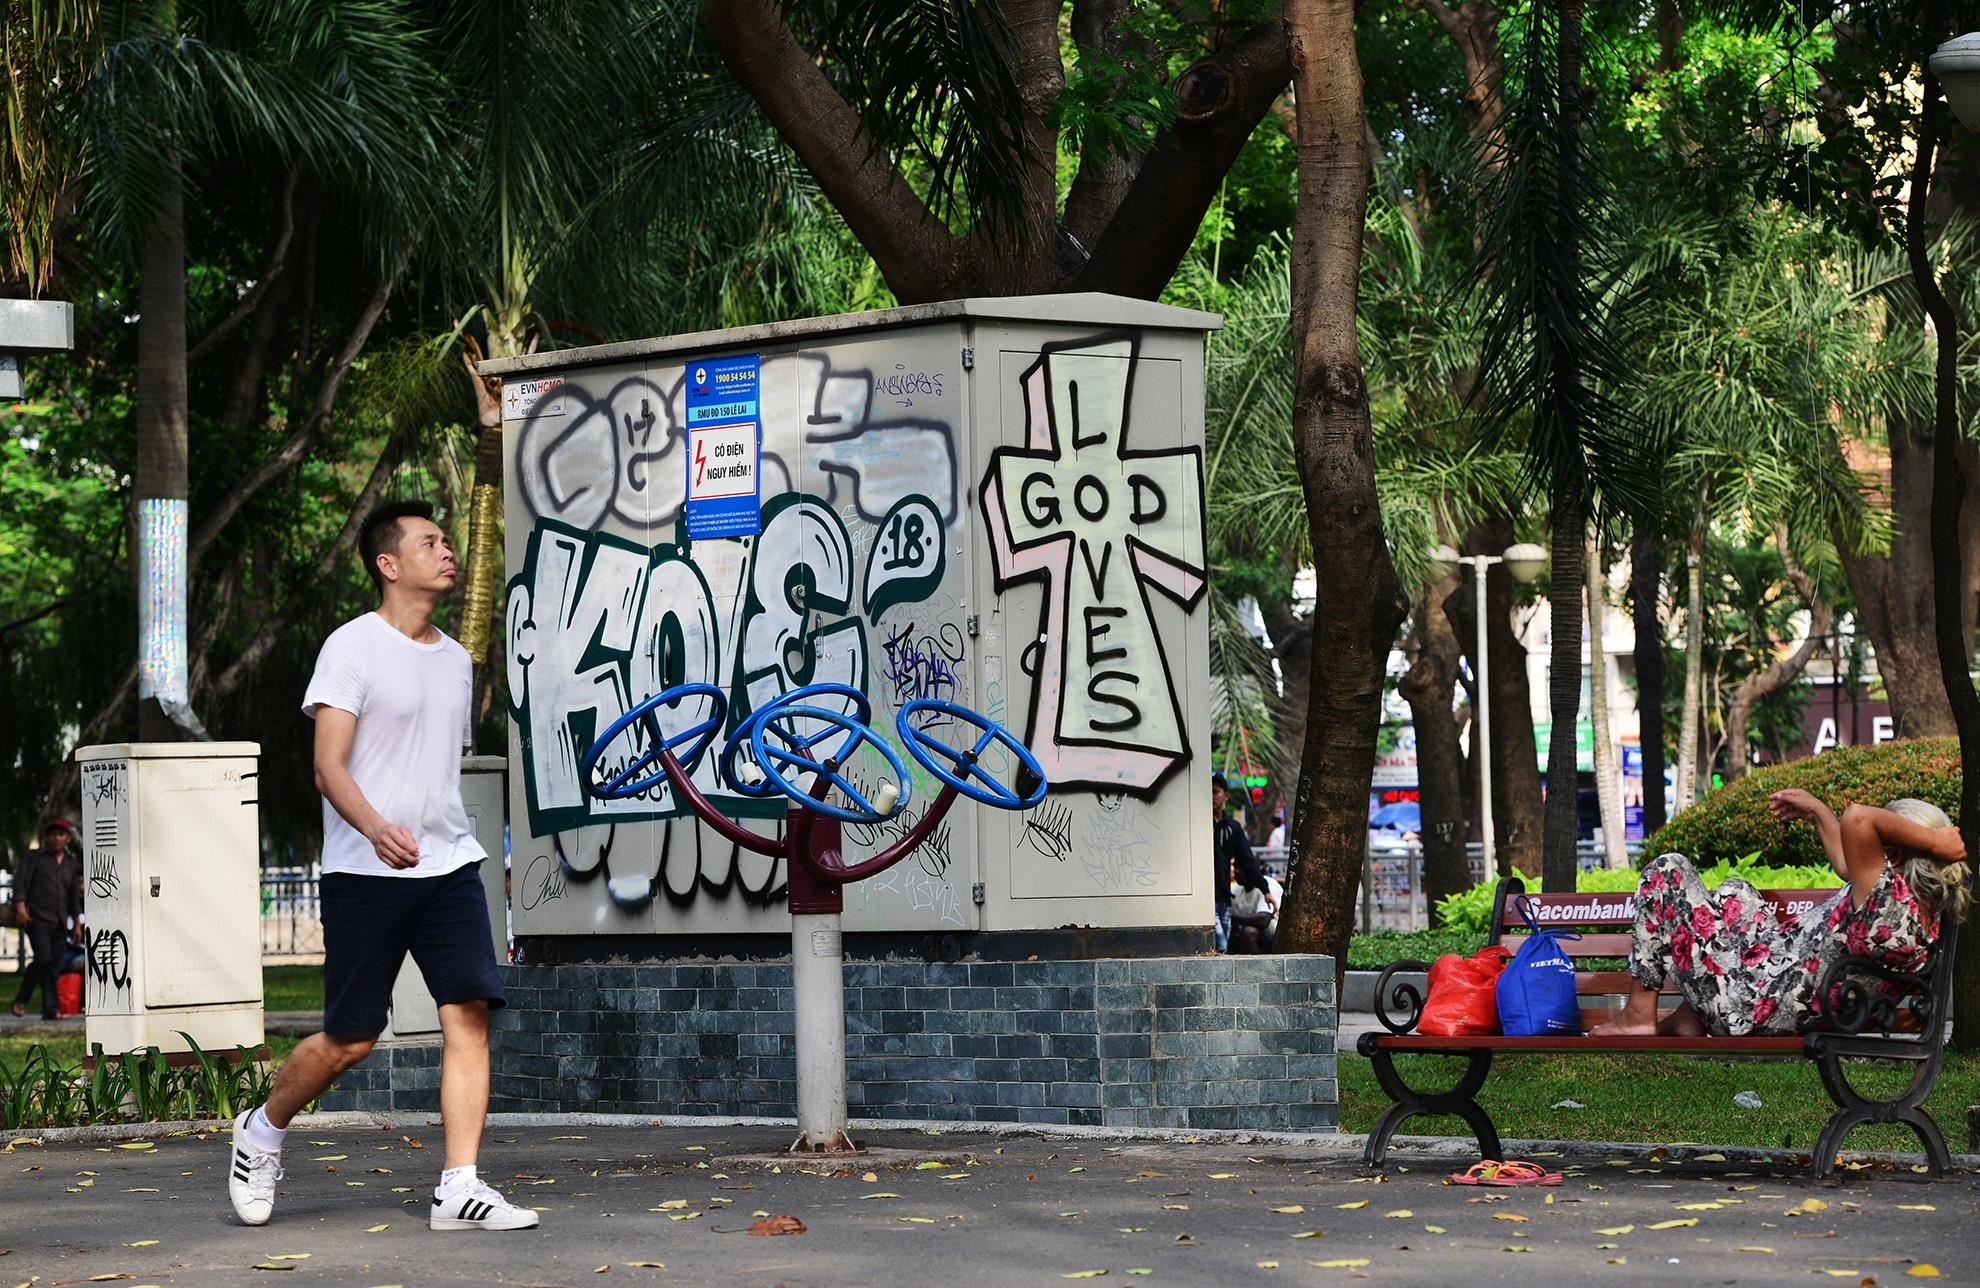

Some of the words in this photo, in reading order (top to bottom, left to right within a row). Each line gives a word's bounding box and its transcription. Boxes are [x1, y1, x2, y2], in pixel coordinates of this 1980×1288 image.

[715, 373, 730, 383] 1900
[731, 372, 739, 382] 54
[739, 371, 747, 381] 54
[748, 370, 756, 380] 54
[697, 407, 710, 419] RMU
[720, 406, 730, 417] 150
[738, 404, 747, 415] LAI
[714, 443, 725, 458] CÓ
[727, 441, 744, 457] ĐIỆN
[707, 466, 727, 480] NGUY
[729, 460, 747, 477] HIỂM
[1021, 471, 1168, 528] GOD
[1525, 897, 1636, 920] Sacombank
